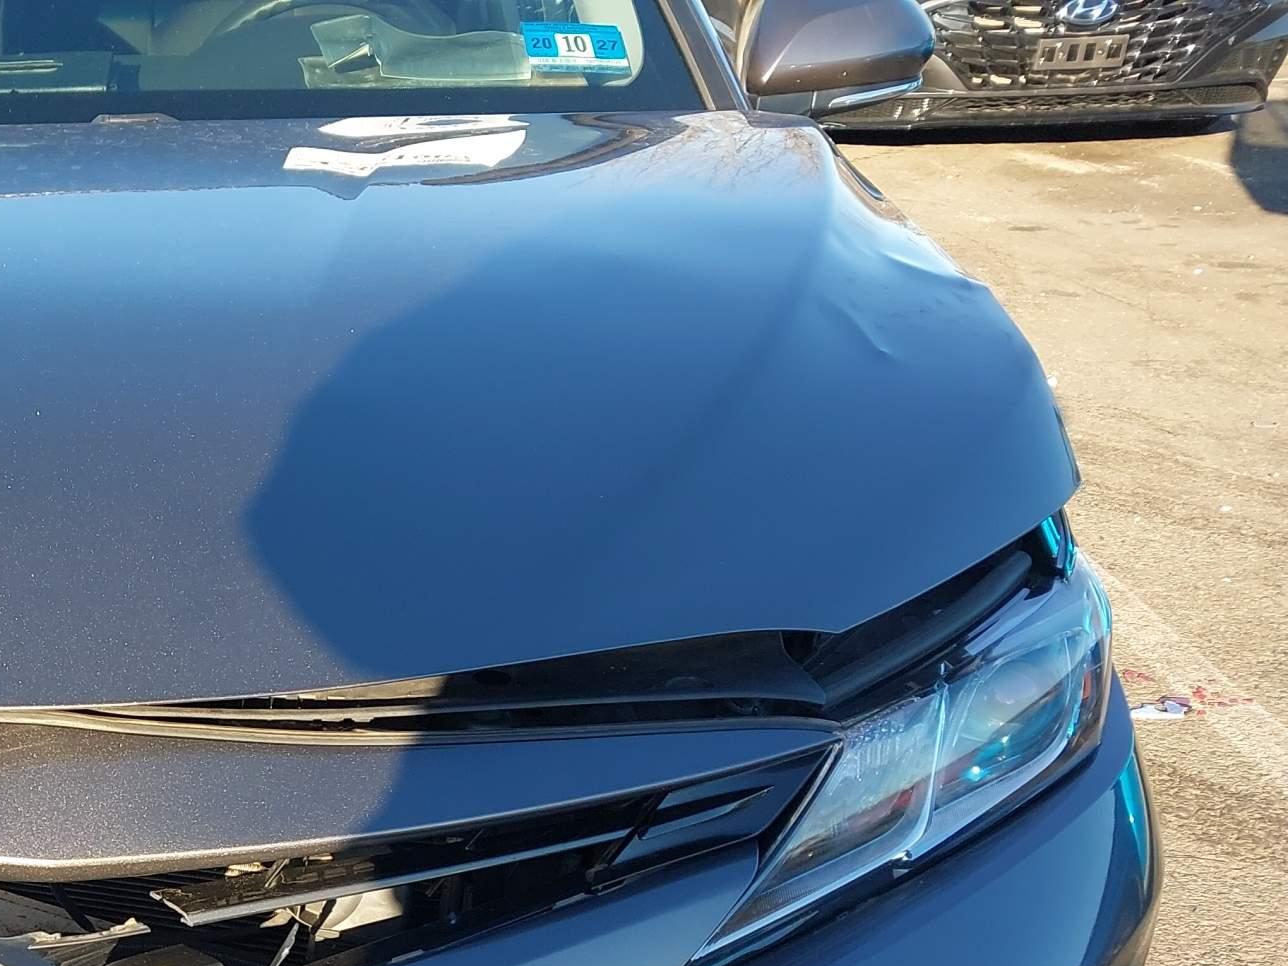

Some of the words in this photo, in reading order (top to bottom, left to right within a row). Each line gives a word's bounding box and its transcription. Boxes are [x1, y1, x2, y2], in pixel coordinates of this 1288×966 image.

[532, 37, 552, 49] 20
[561, 35, 587, 53] 10
[597, 40, 618, 51] 27
